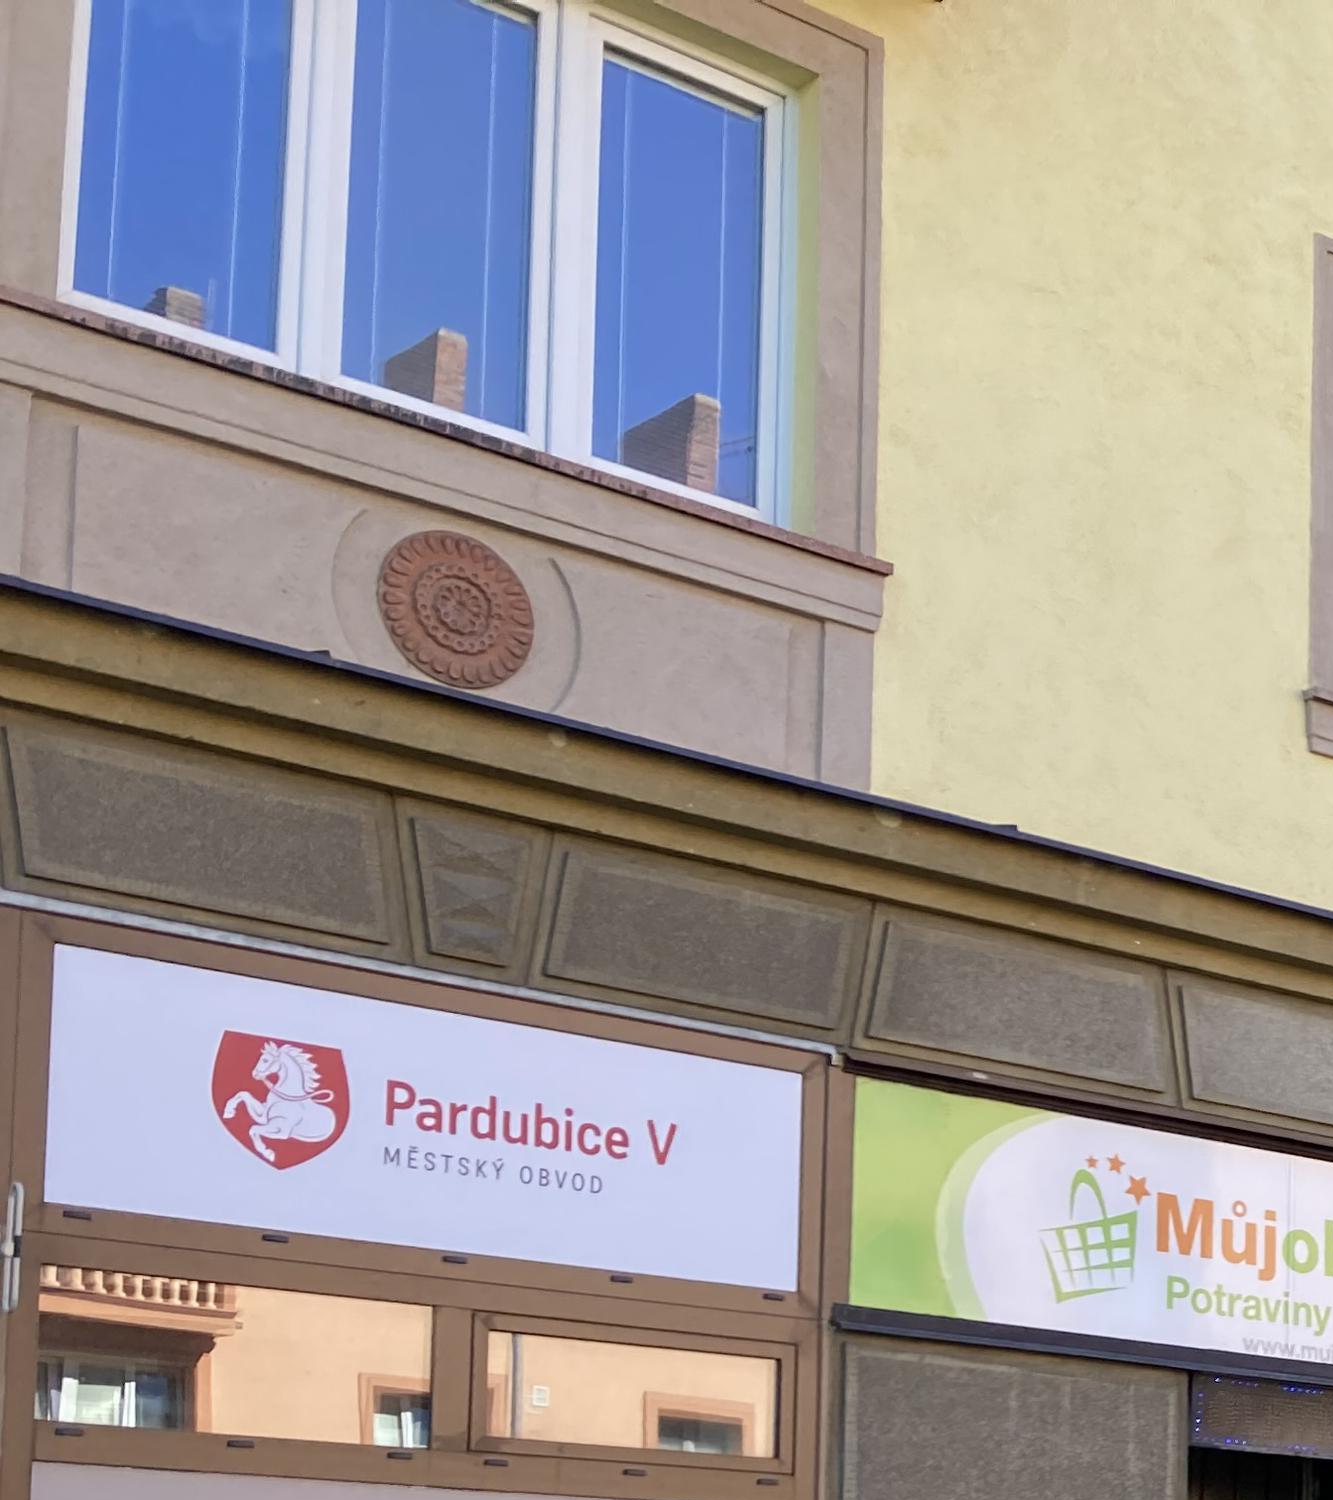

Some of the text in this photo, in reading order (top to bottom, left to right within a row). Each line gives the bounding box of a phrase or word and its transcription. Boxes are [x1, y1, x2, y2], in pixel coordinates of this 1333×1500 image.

[385, 1079, 677, 1165] Pardubice V
[383, 1145, 602, 1194] MĚSTSKÝ OBVOD
[1166, 1275, 1331, 1336] Potraviny
